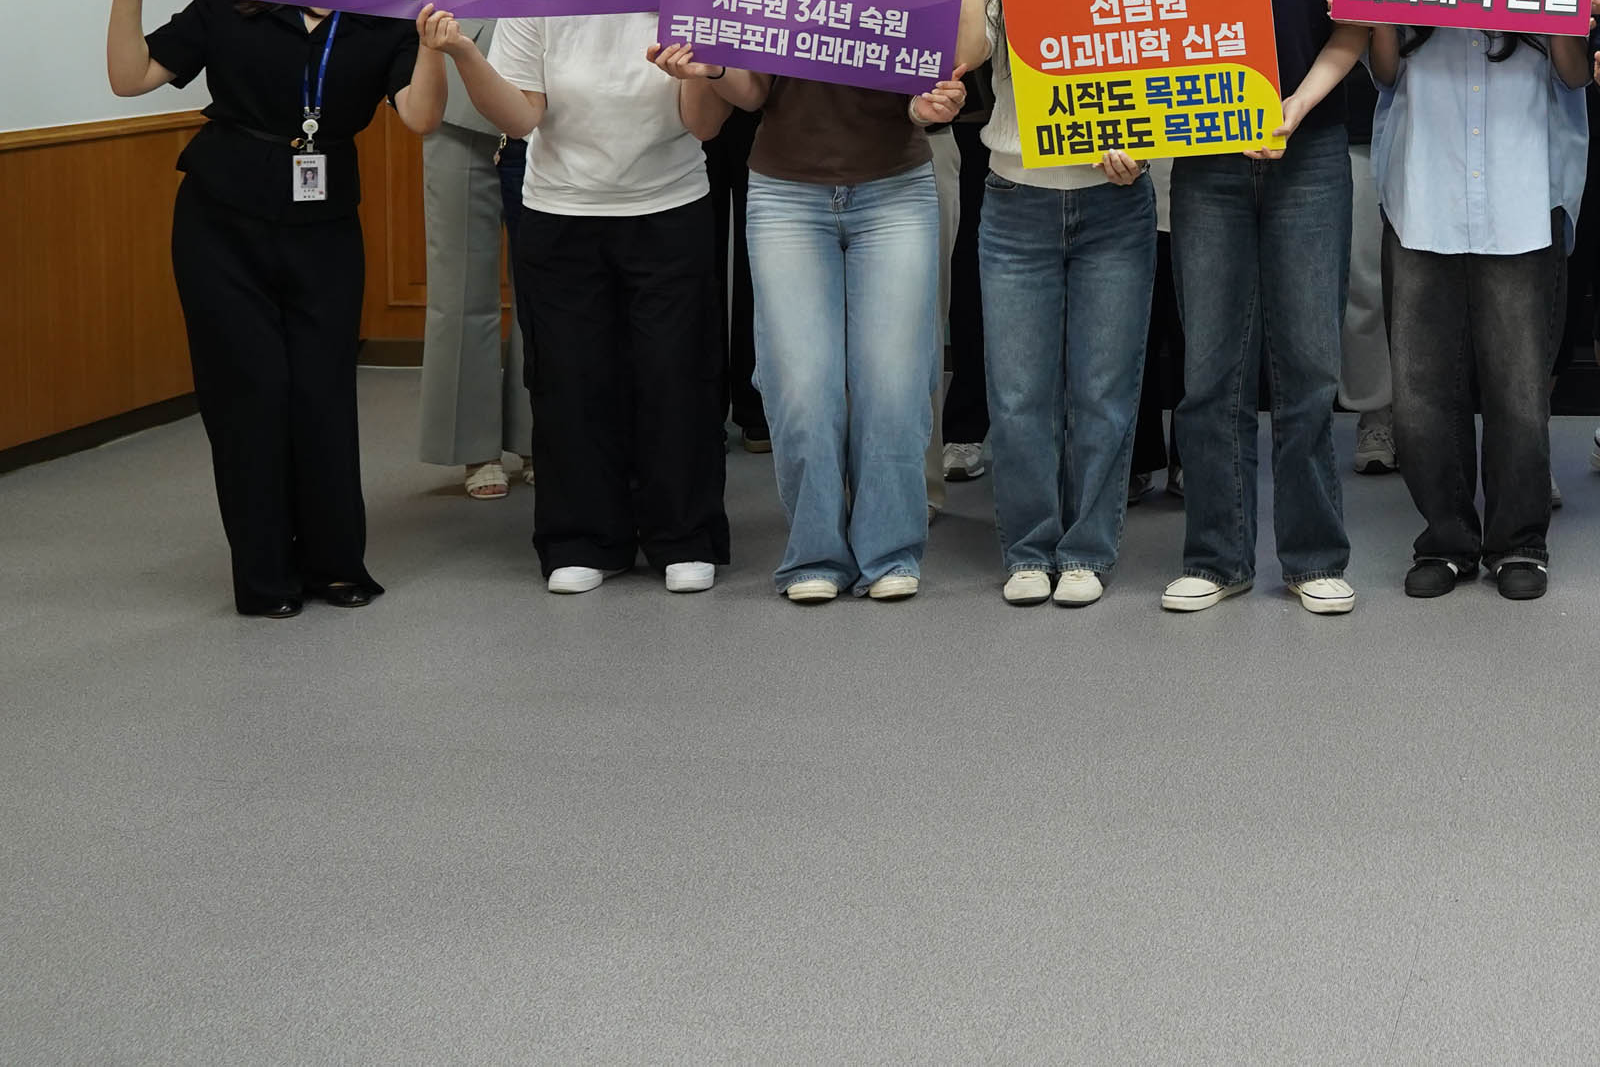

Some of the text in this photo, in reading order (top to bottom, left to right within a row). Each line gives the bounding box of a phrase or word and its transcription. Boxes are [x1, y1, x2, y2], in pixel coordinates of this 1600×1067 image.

[858, 6, 909, 38] 숙원
[1040, 21, 1247, 70] 의과대학 신설
[671, 14, 942, 79] 국립목포대 의과대학 신설
[1048, 71, 1245, 116] 시작도 목포대!
[1036, 109, 1264, 156] 마침표도 목포대!
